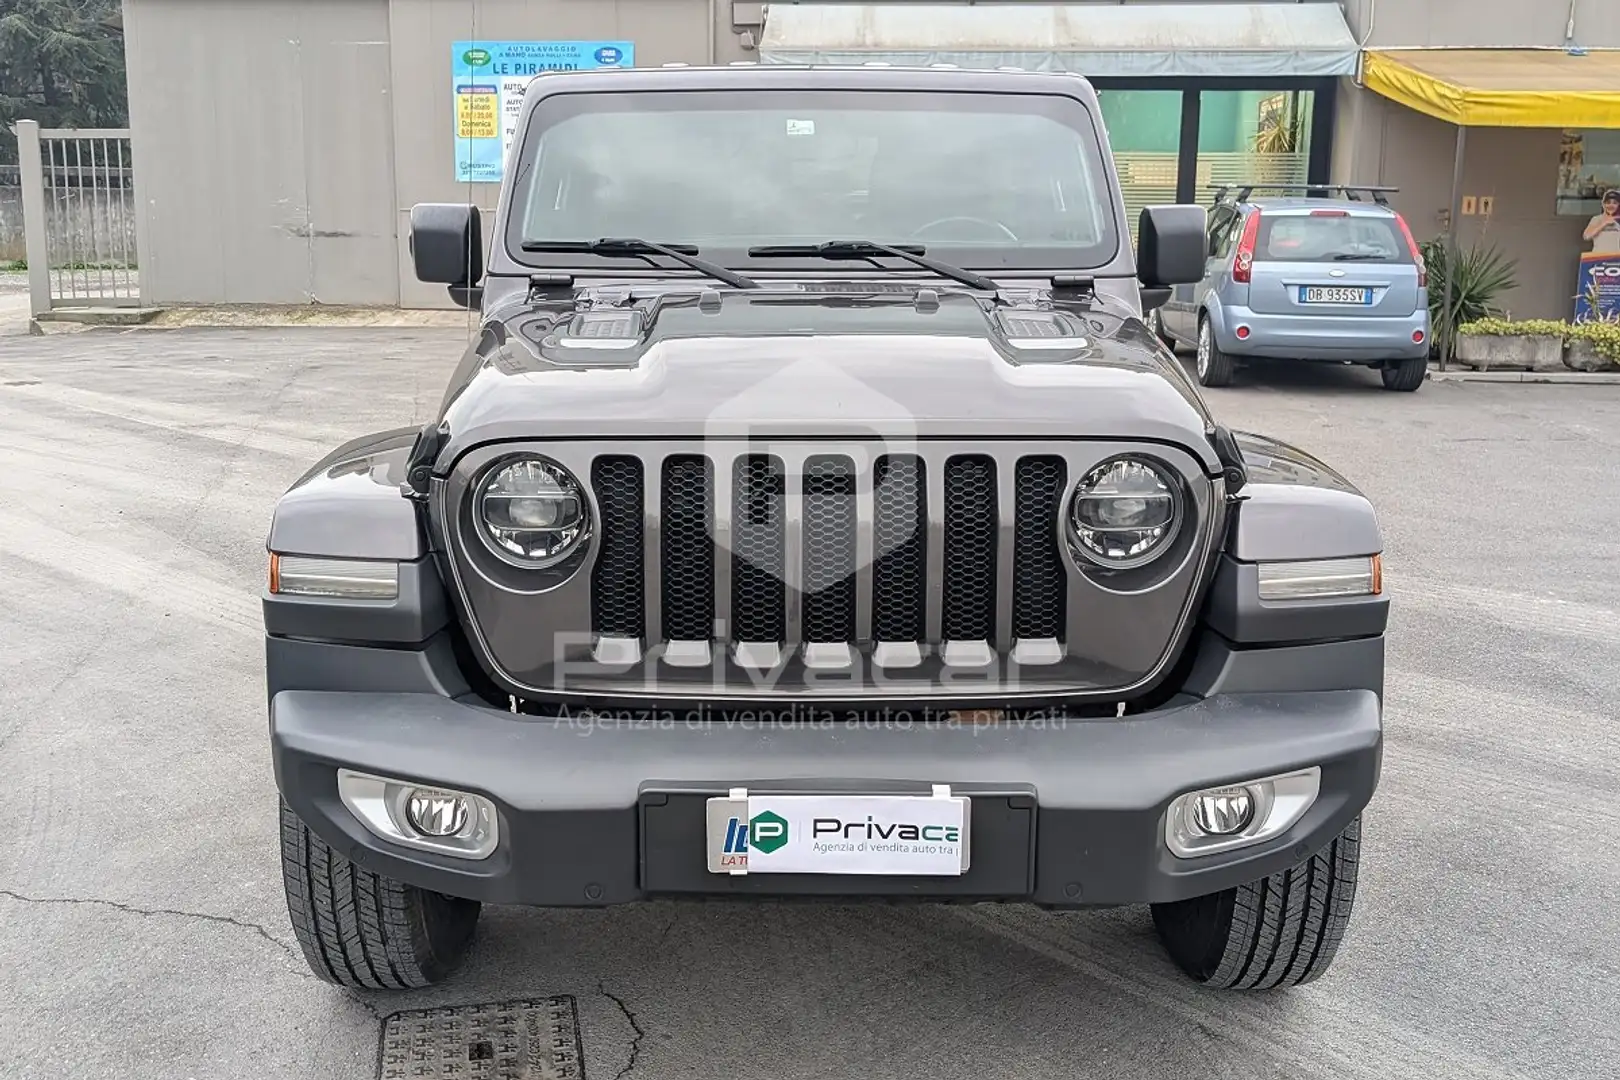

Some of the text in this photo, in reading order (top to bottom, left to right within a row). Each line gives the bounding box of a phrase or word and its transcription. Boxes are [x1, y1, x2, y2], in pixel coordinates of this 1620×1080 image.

[492, 62, 578, 75] LE PIRAMIDI
[1308, 288, 1364, 301] DB 935SV
[813, 841, 854, 855] Agenzia
[857, 842, 869, 852] di
[871, 843, 910, 853] vendita
[912, 845, 936, 854] auto
[938, 845, 953, 854] tra
[721, 856, 736, 865] LA
